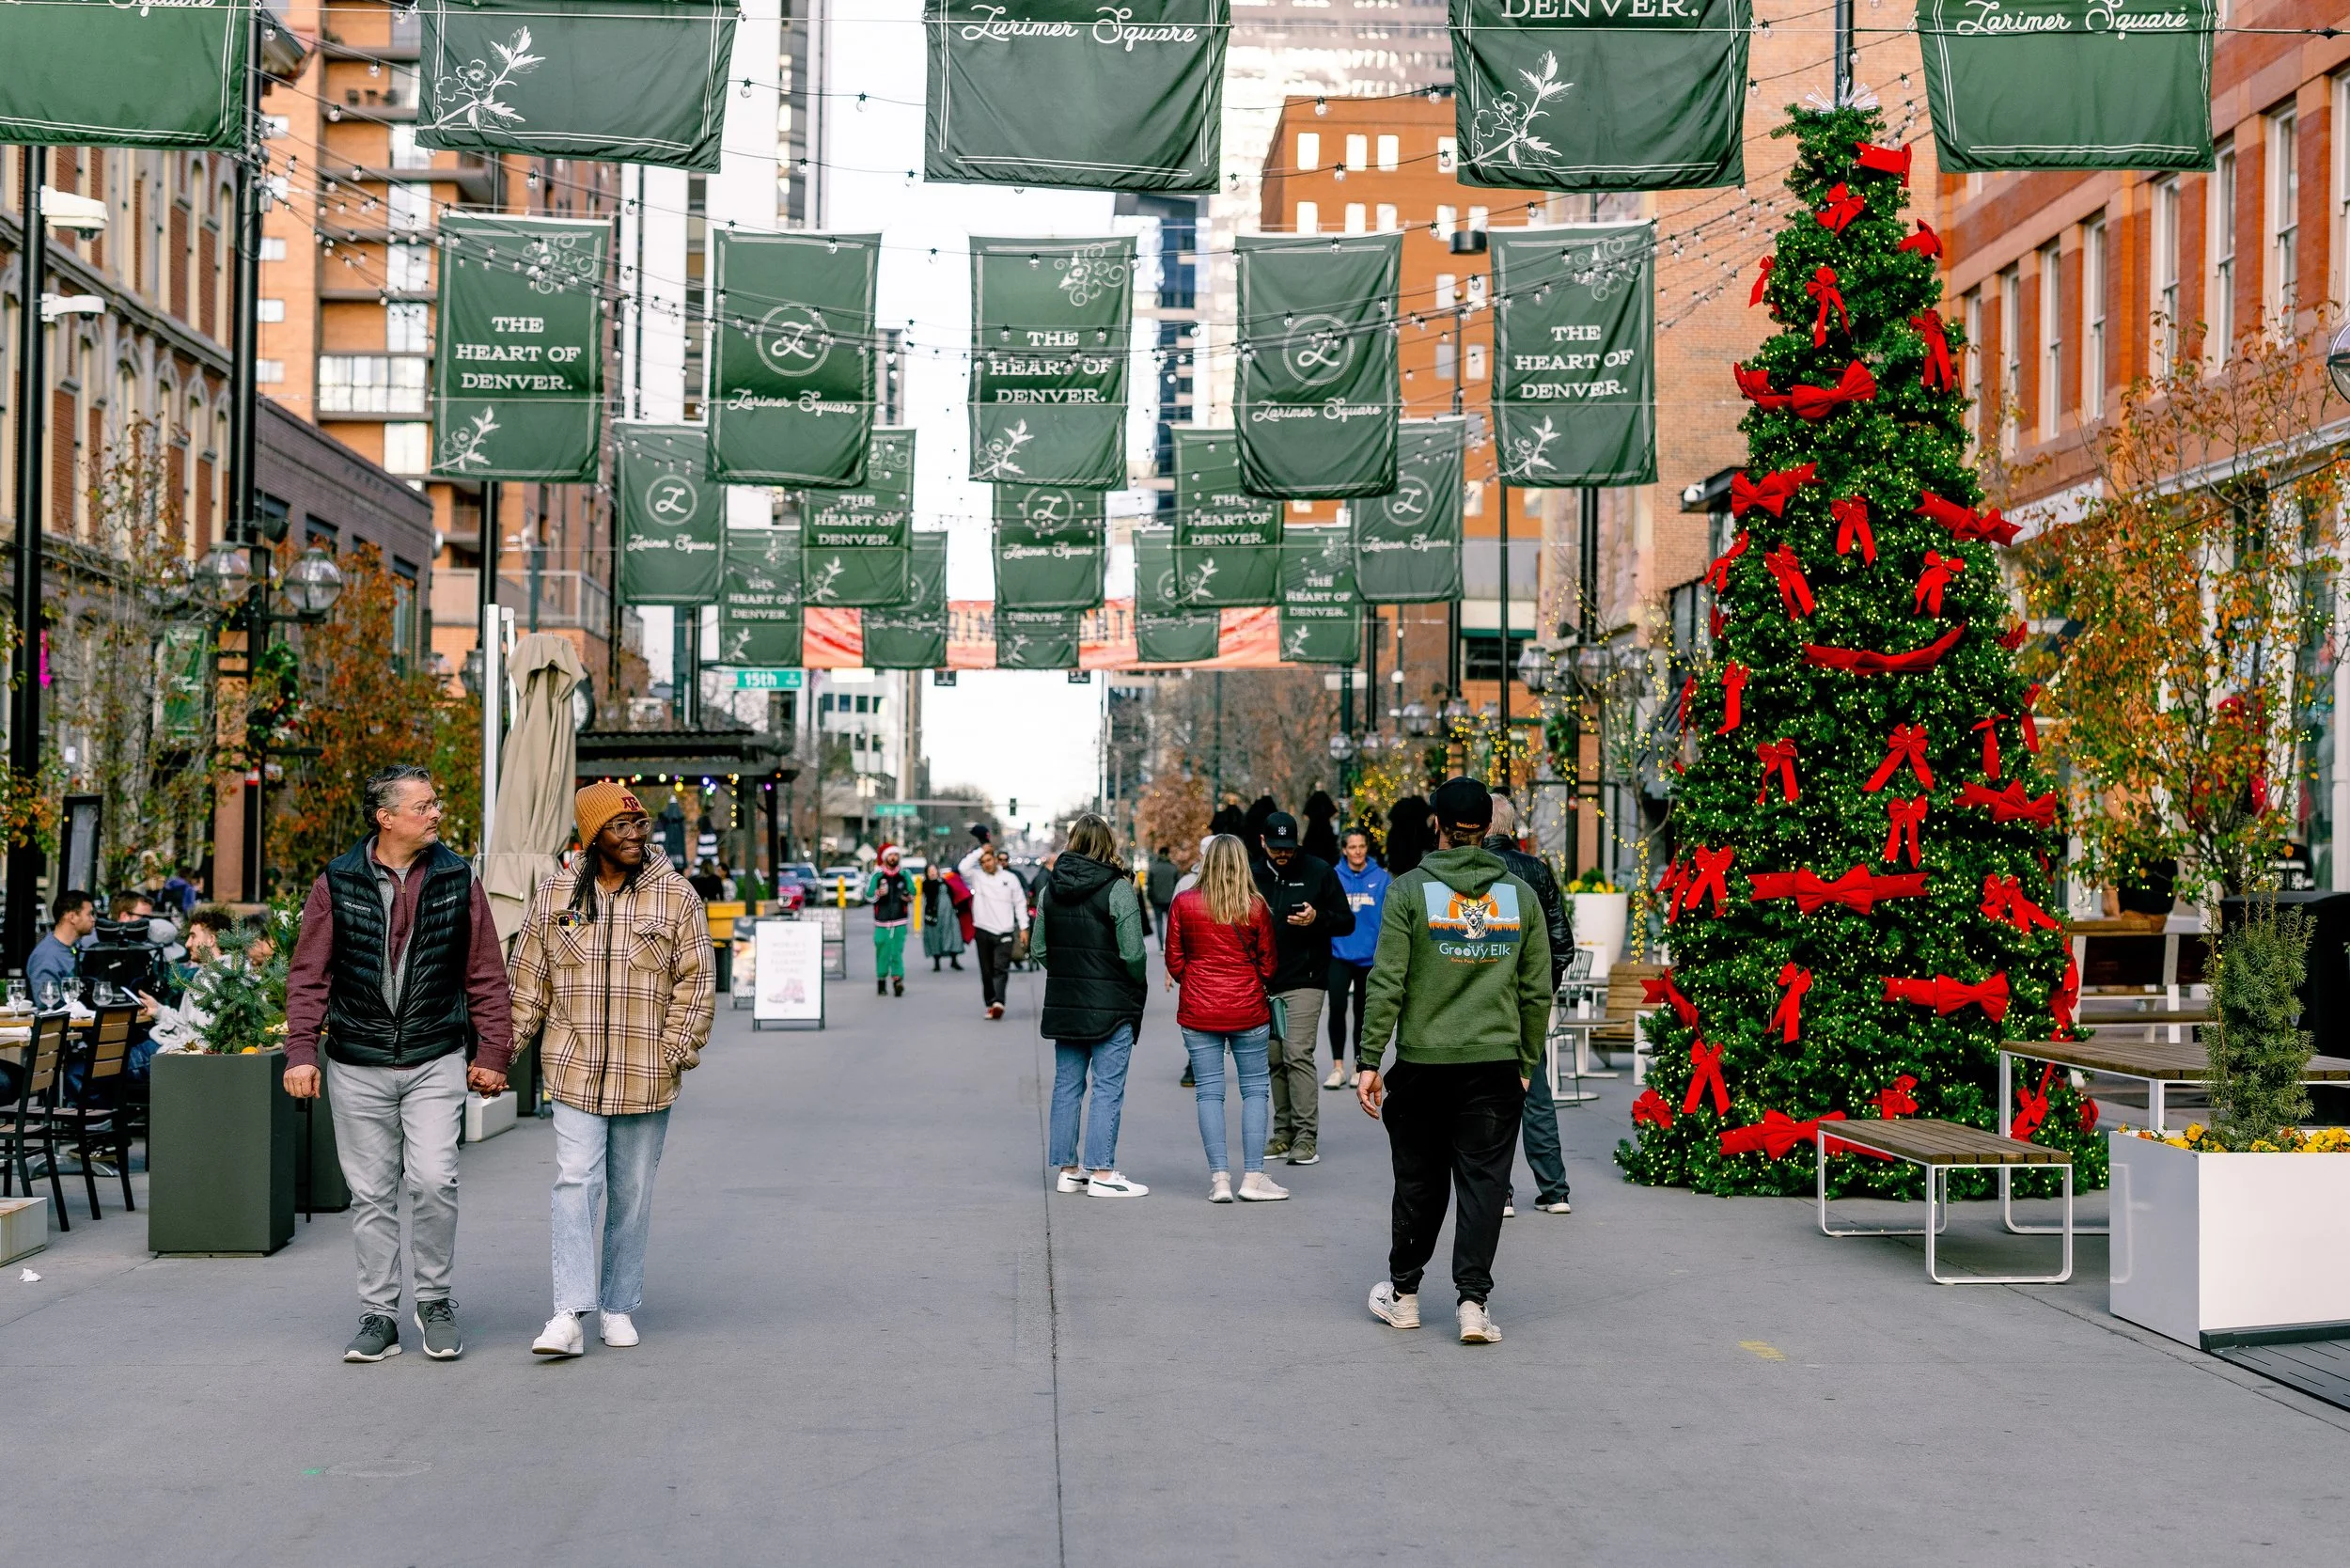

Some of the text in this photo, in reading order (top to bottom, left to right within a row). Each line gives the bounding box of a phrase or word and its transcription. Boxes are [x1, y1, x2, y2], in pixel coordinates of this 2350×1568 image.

[1501, 0, 1700, 19] DENVER.
[961, 4, 1198, 53] Larimer Square
[1956, 0, 2189, 40] Larimer Square
[491, 316, 544, 333] THE
[1550, 324, 1602, 342] THE
[1026, 330, 1079, 347] THE
[455, 343, 582, 363] HEART OF
[1514, 348, 1635, 371] HEART OF
[461, 372, 573, 390] DENVER.
[1520, 379, 1628, 400] DENVER.
[727, 387, 857, 417] Larimer Square
[995, 387, 1106, 403] DENVER.
[1251, 397, 1382, 423] Larimer Square
[814, 513, 874, 526] HEART
[1248, 512, 1274, 525] OF
[818, 533, 894, 545] DENVER.
[1191, 532, 1266, 545] DENVER.
[744, 671, 777, 687] 15th
[1491, 944, 1512, 956] Elk
